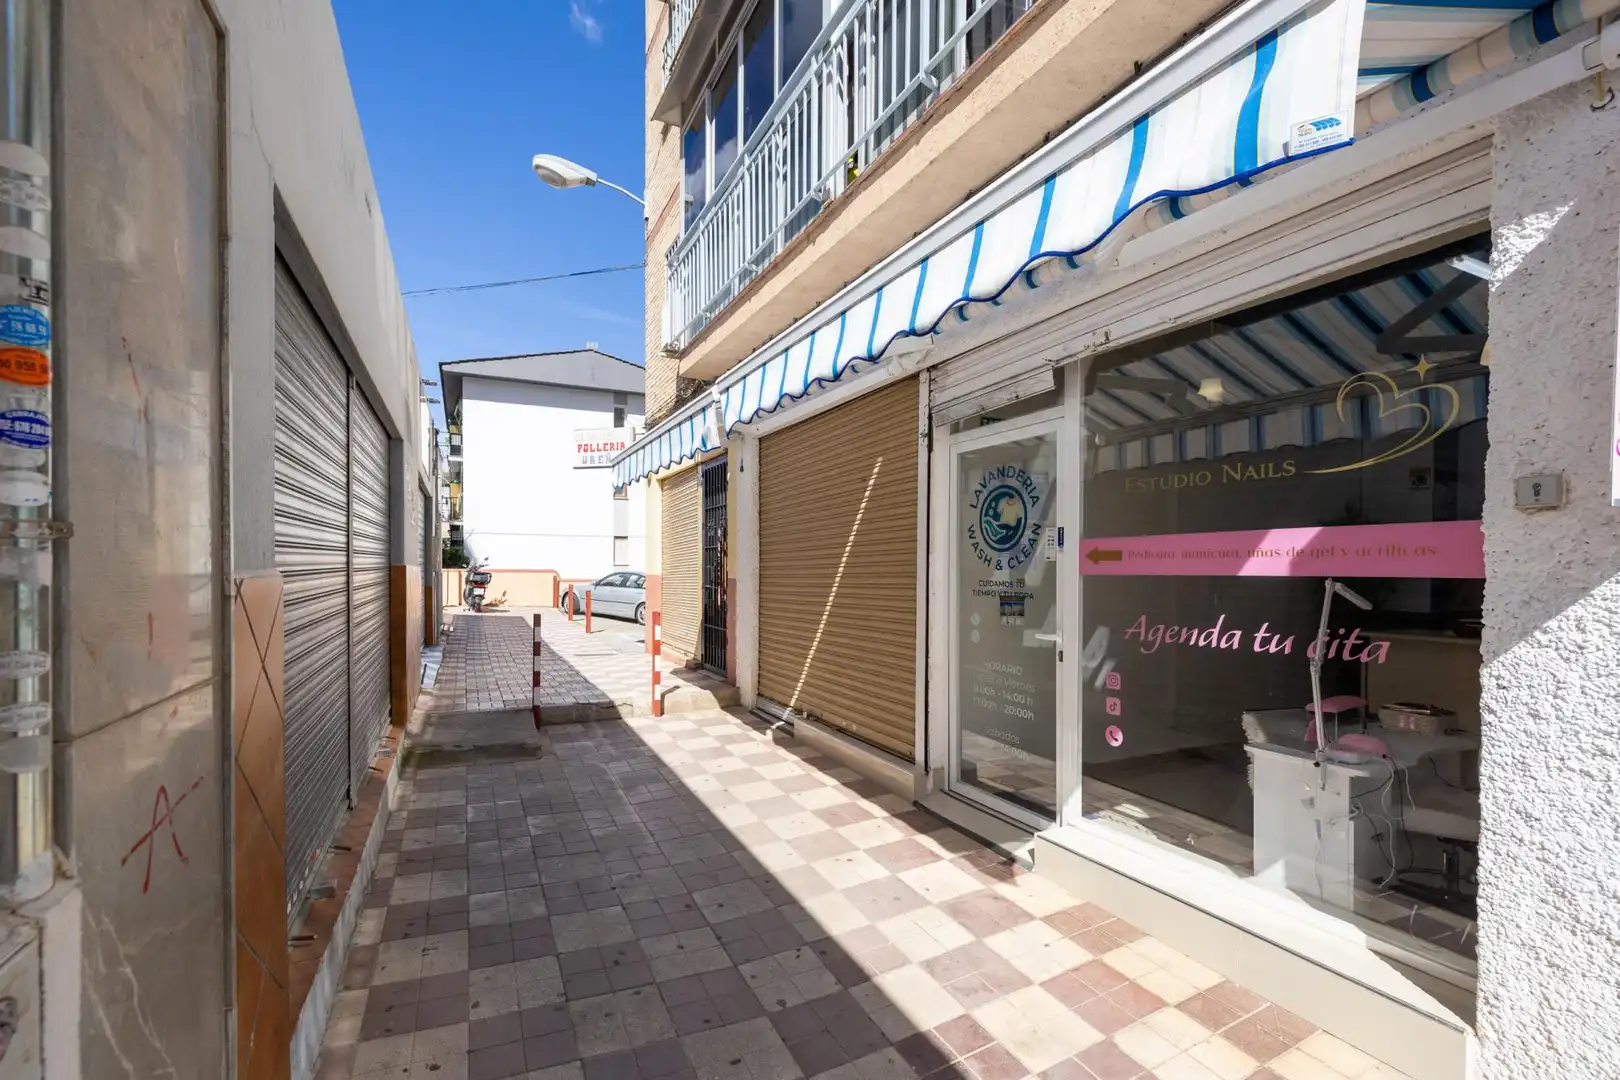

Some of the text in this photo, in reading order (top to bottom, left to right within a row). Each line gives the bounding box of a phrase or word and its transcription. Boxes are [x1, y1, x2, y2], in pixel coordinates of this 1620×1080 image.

[577, 441, 626, 453] POLLERIA
[1125, 460, 1297, 493] ESTUDIO NAILS
[969, 465, 1040, 509] LAVANDERIA
[967, 523, 992, 567] WASH
[995, 559, 1004, 571] &
[1007, 523, 1042, 569] CLEAN
[1286, 546, 1305, 557] de
[978, 579, 1013, 588] CUIDAMOS
[972, 589, 996, 598] TIEMPO
[1124, 614, 1391, 664] Agenda tu cita
[983, 660, 1023, 676] HORARIO
[1004, 704, 1034, 721] 20:00h
